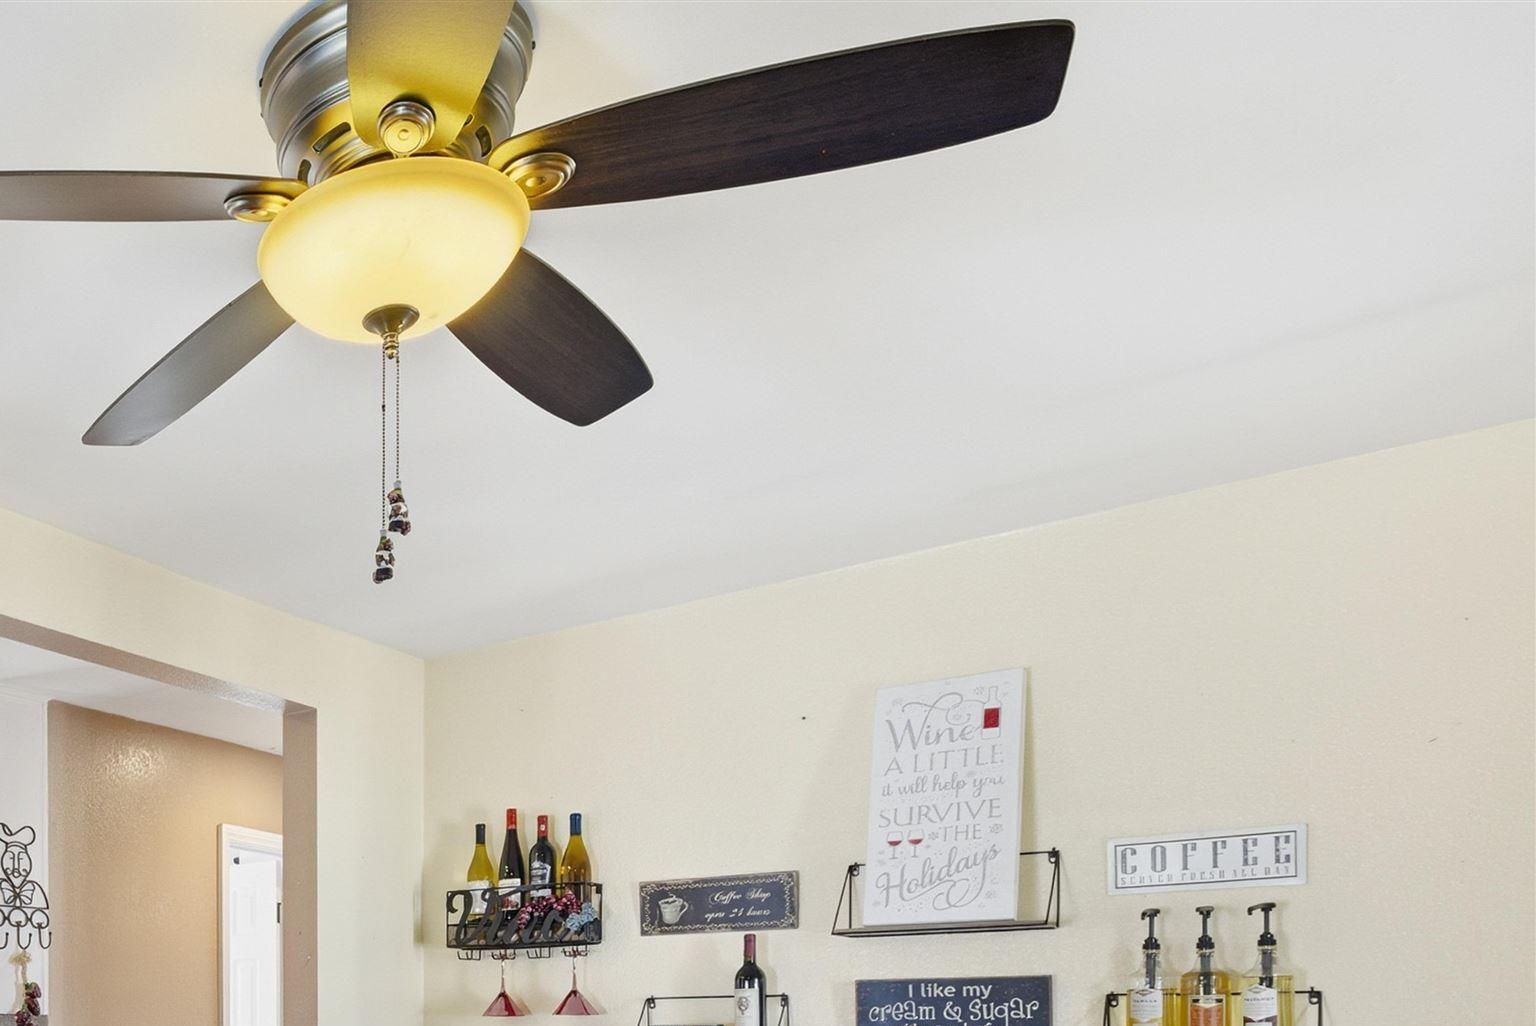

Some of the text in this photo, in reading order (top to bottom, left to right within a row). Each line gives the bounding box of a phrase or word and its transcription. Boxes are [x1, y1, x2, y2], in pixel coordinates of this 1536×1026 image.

[885, 692, 982, 752] Wine
[884, 744, 1004, 776] A LITTLE
[898, 775, 928, 795] will
[932, 772, 967, 799] help
[972, 776, 1005, 798] you
[878, 798, 1002, 828] SURVIVE
[943, 824, 983, 842] THE
[1120, 834, 1292, 875] COFFEE
[875, 843, 1002, 910] Holidays
[1181, 870, 1226, 881] FRESH
[1264, 866, 1291, 876] DAY
[709, 888, 772, 905] Coffee Shop
[909, 983, 992, 999] I like my
[869, 1000, 936, 1022] cream
[943, 1001, 964, 1023] &
